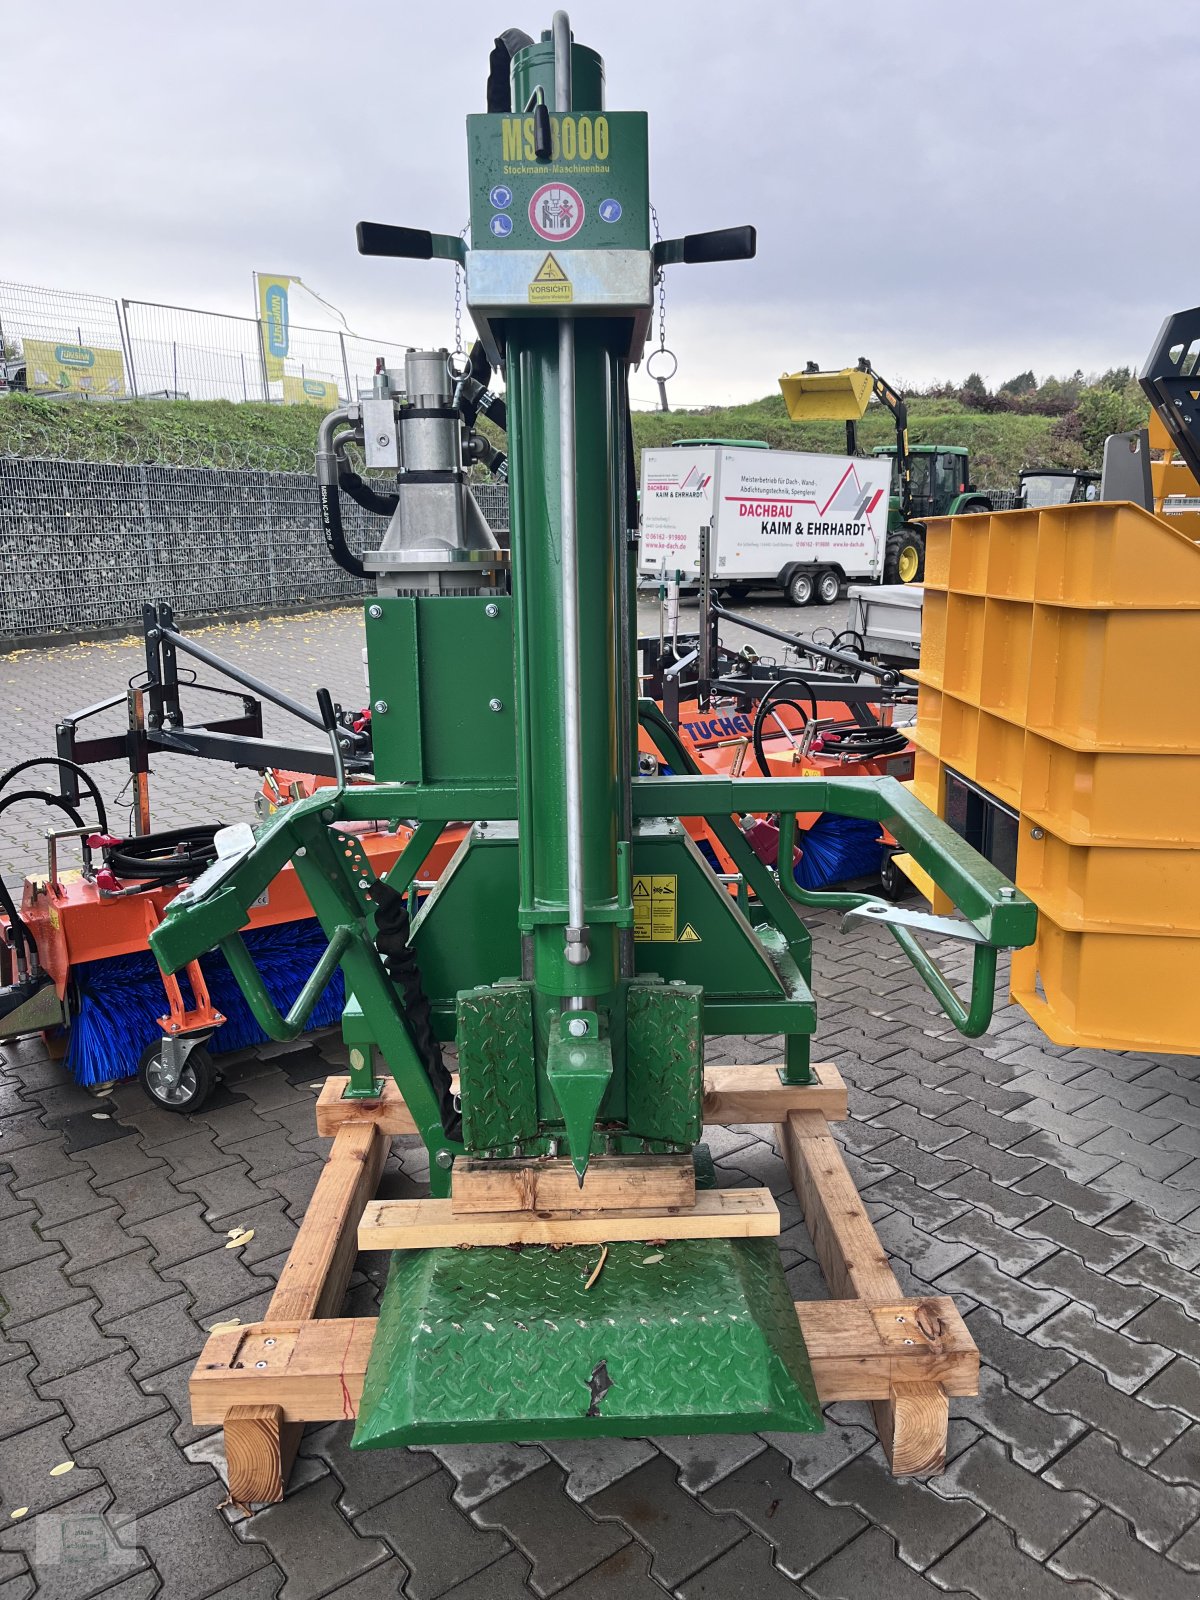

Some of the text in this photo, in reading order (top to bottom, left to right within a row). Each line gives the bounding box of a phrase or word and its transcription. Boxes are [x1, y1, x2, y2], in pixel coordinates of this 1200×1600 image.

[503, 164, 610, 175] Stockmann-Maschinenbau
[740, 475, 778, 484] Meisterbetrieb
[739, 503, 793, 518] DACHBAU
[761, 521, 866, 536] KAIM & EHRHARDT
